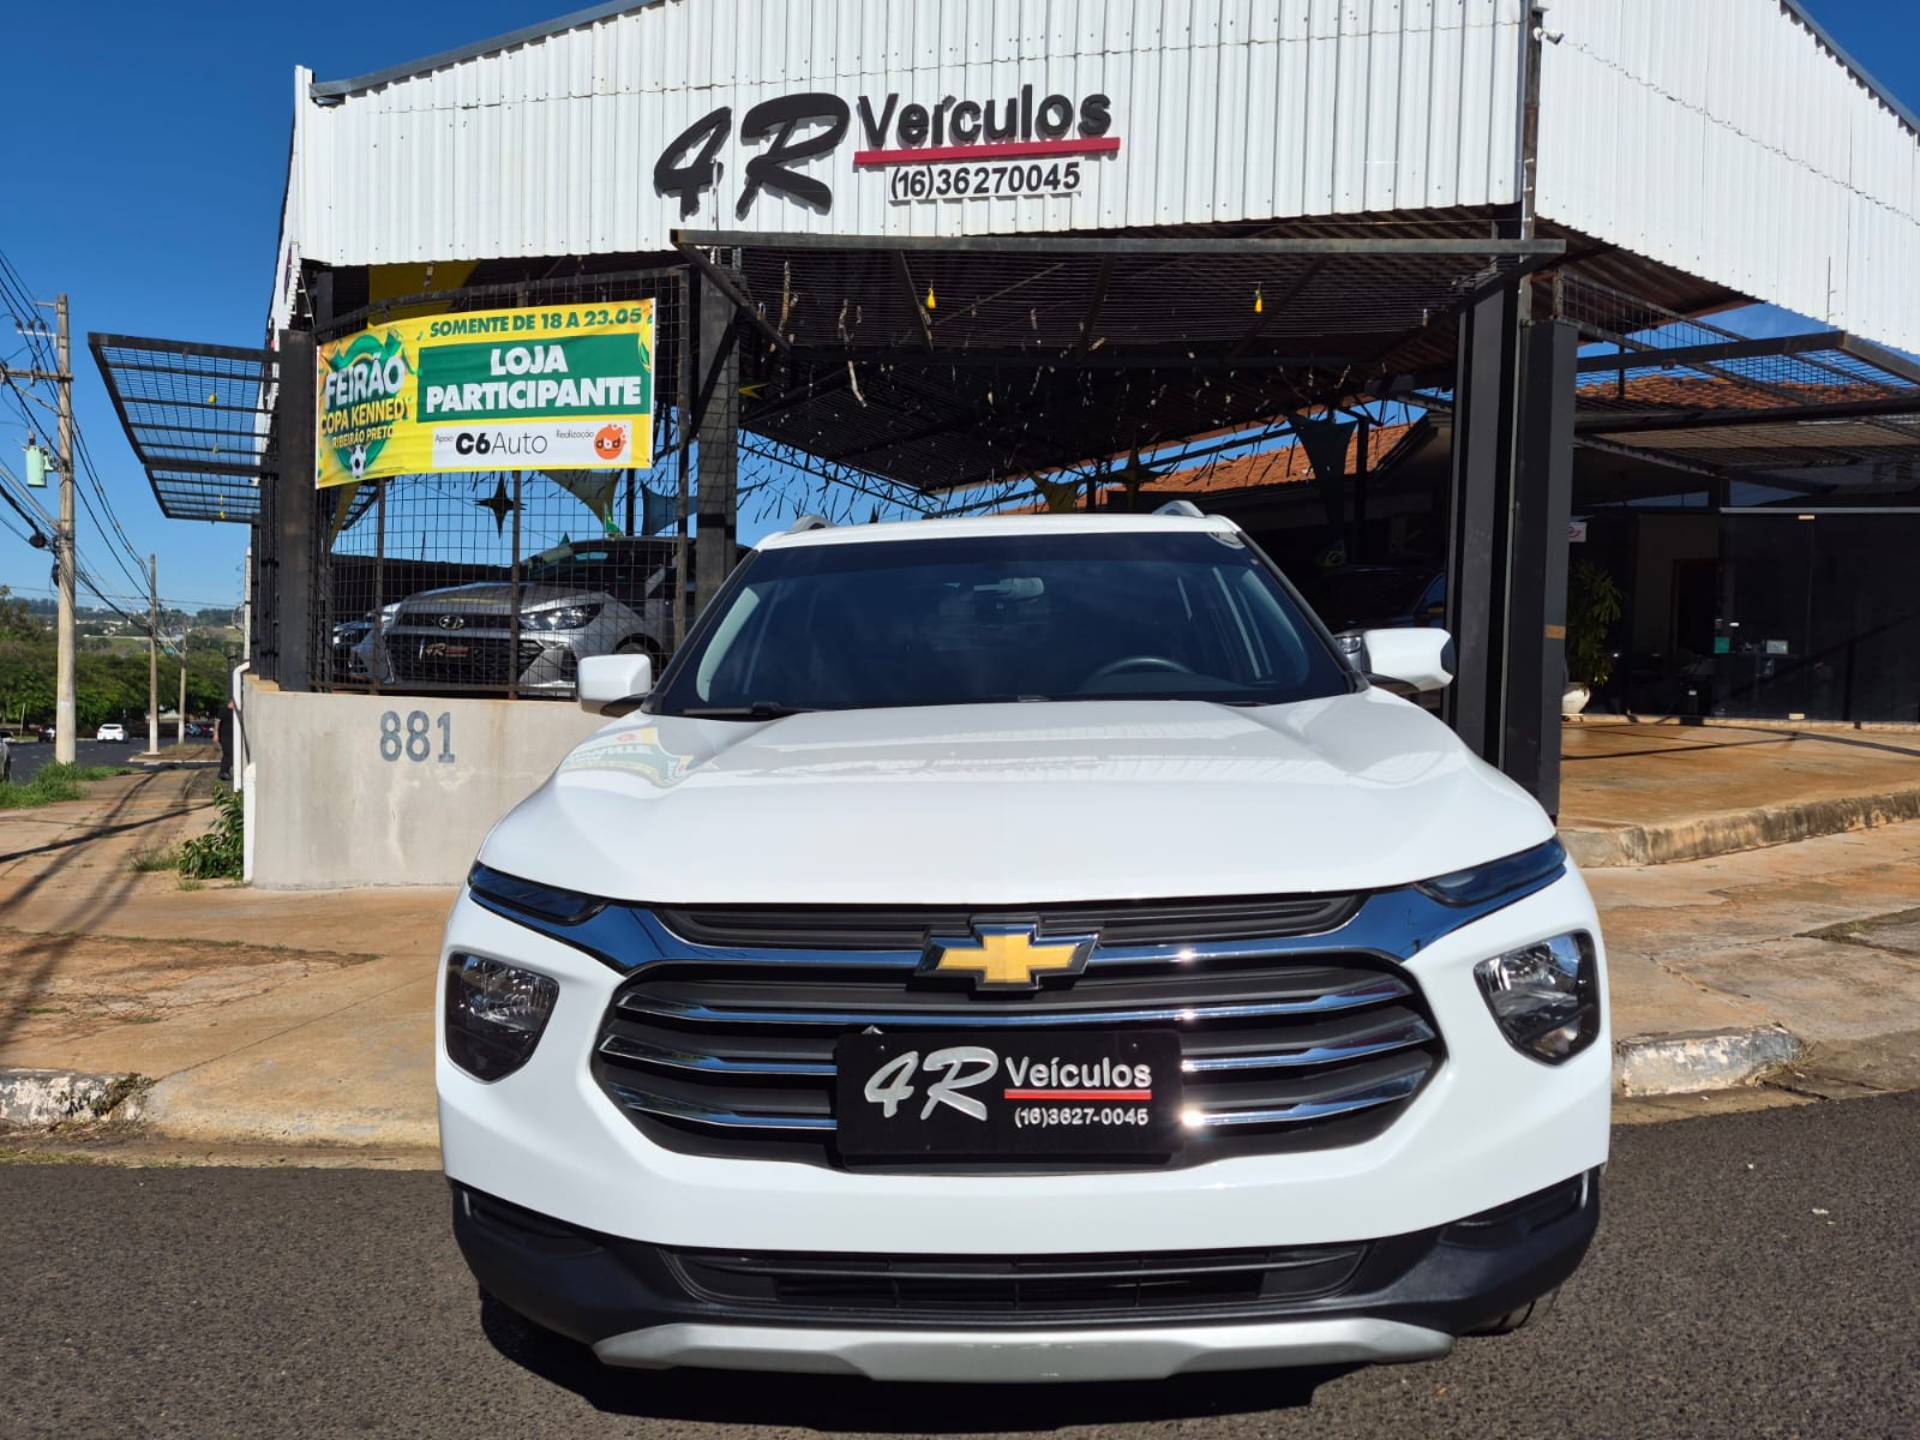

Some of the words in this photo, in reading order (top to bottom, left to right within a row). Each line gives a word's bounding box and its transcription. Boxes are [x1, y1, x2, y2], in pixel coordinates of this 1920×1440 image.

[654, 92, 850, 221] 4R
[859, 84, 1112, 149] Veículos
[890, 161, 1081, 199] (16)36270045
[430, 315, 508, 337] SOMENTE
[512, 314, 535, 331] DE
[541, 312, 562, 329] 18
[566, 311, 580, 328] A
[584, 307, 642, 327] 23.05
[490, 345, 568, 376] LOJA
[325, 352, 404, 410] FEIRÃO
[426, 376, 642, 414] PARTICIPANTE
[321, 408, 349, 434] COPA
[366, 424, 393, 442] PRETO
[380, 710, 455, 763] 881
[864, 1046, 999, 1122] 4R
[1005, 1056, 1152, 1088] Veículos
